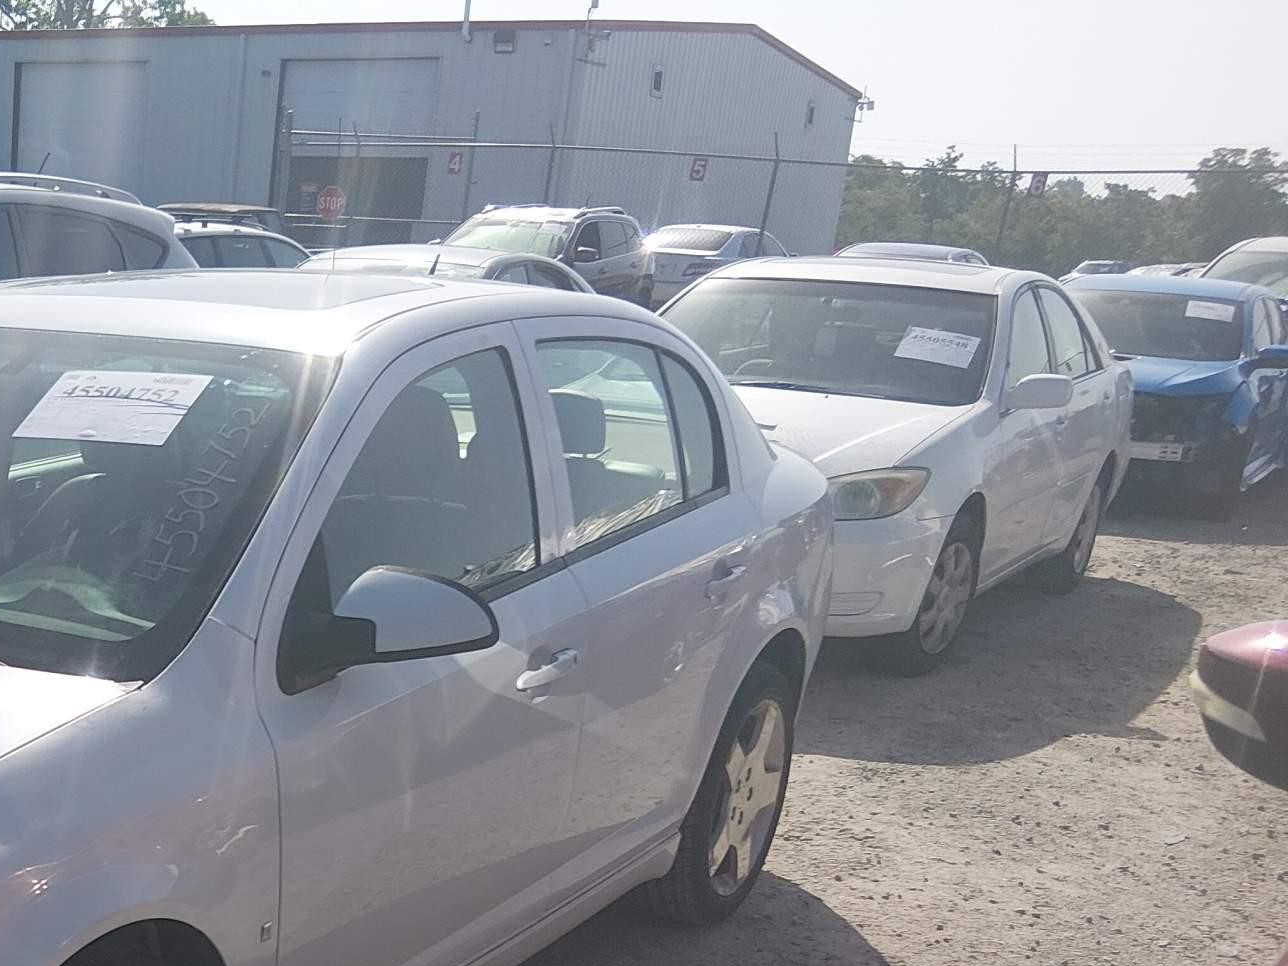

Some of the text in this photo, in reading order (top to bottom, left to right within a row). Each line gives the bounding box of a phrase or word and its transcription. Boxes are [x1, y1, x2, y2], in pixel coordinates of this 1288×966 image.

[449, 153, 461, 172] 4
[693, 160, 705, 178] 5
[1030, 175, 1044, 193] 6
[319, 197, 344, 210] STOP
[63, 385, 180, 402] 45504752
[133, 401, 271, 581] 45504752
